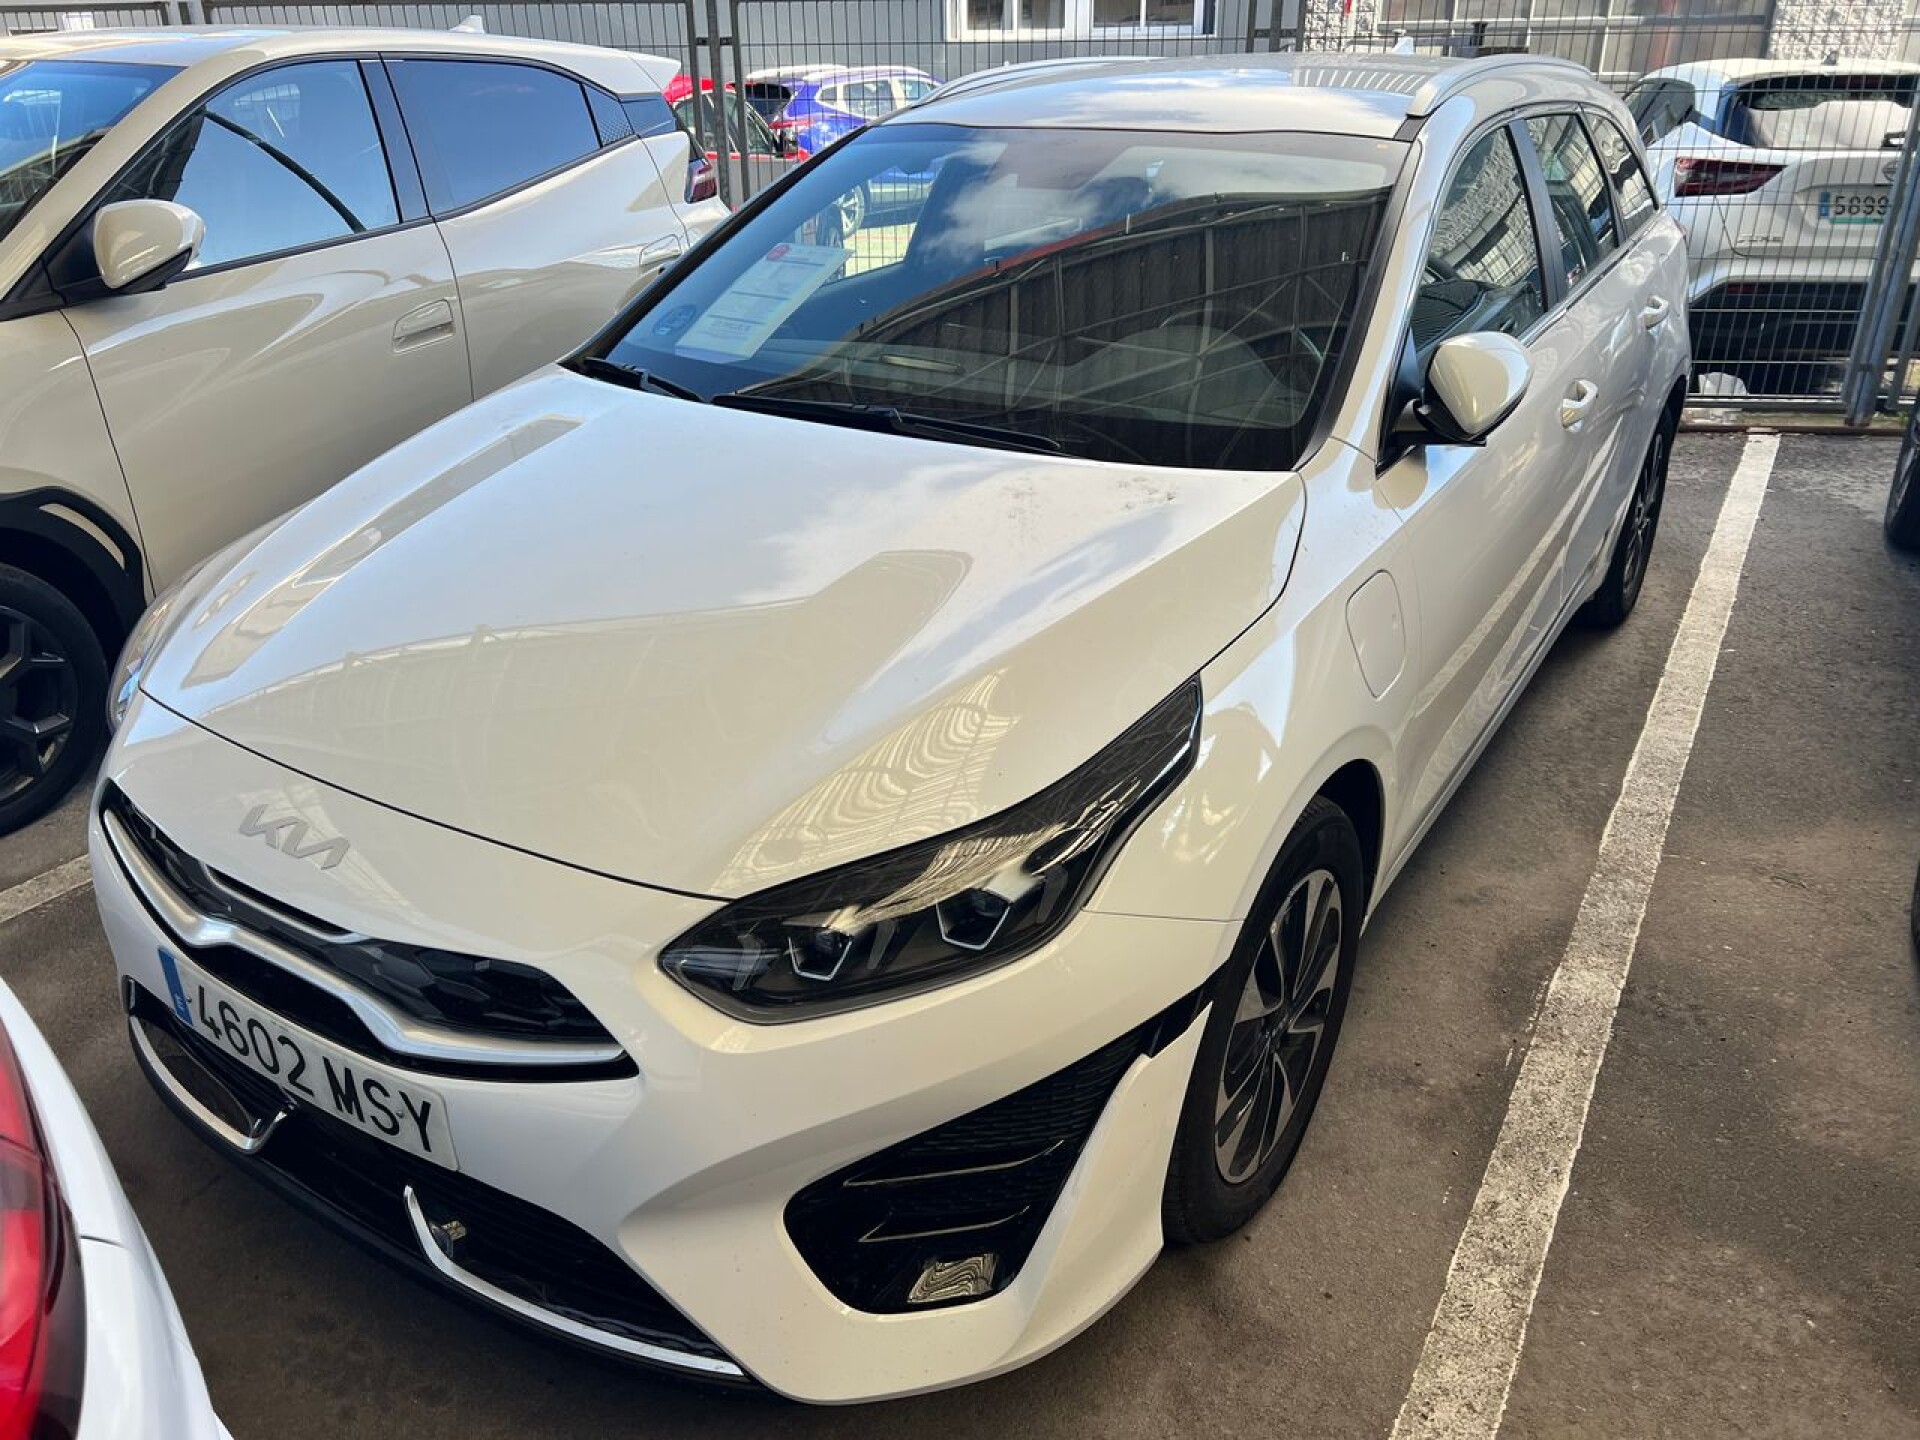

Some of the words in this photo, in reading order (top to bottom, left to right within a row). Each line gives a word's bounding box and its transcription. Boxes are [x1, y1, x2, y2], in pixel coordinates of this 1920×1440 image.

[238, 803, 351, 871] KIA
[198, 984, 315, 1098] 4602
[322, 1055, 432, 1153] MSY
